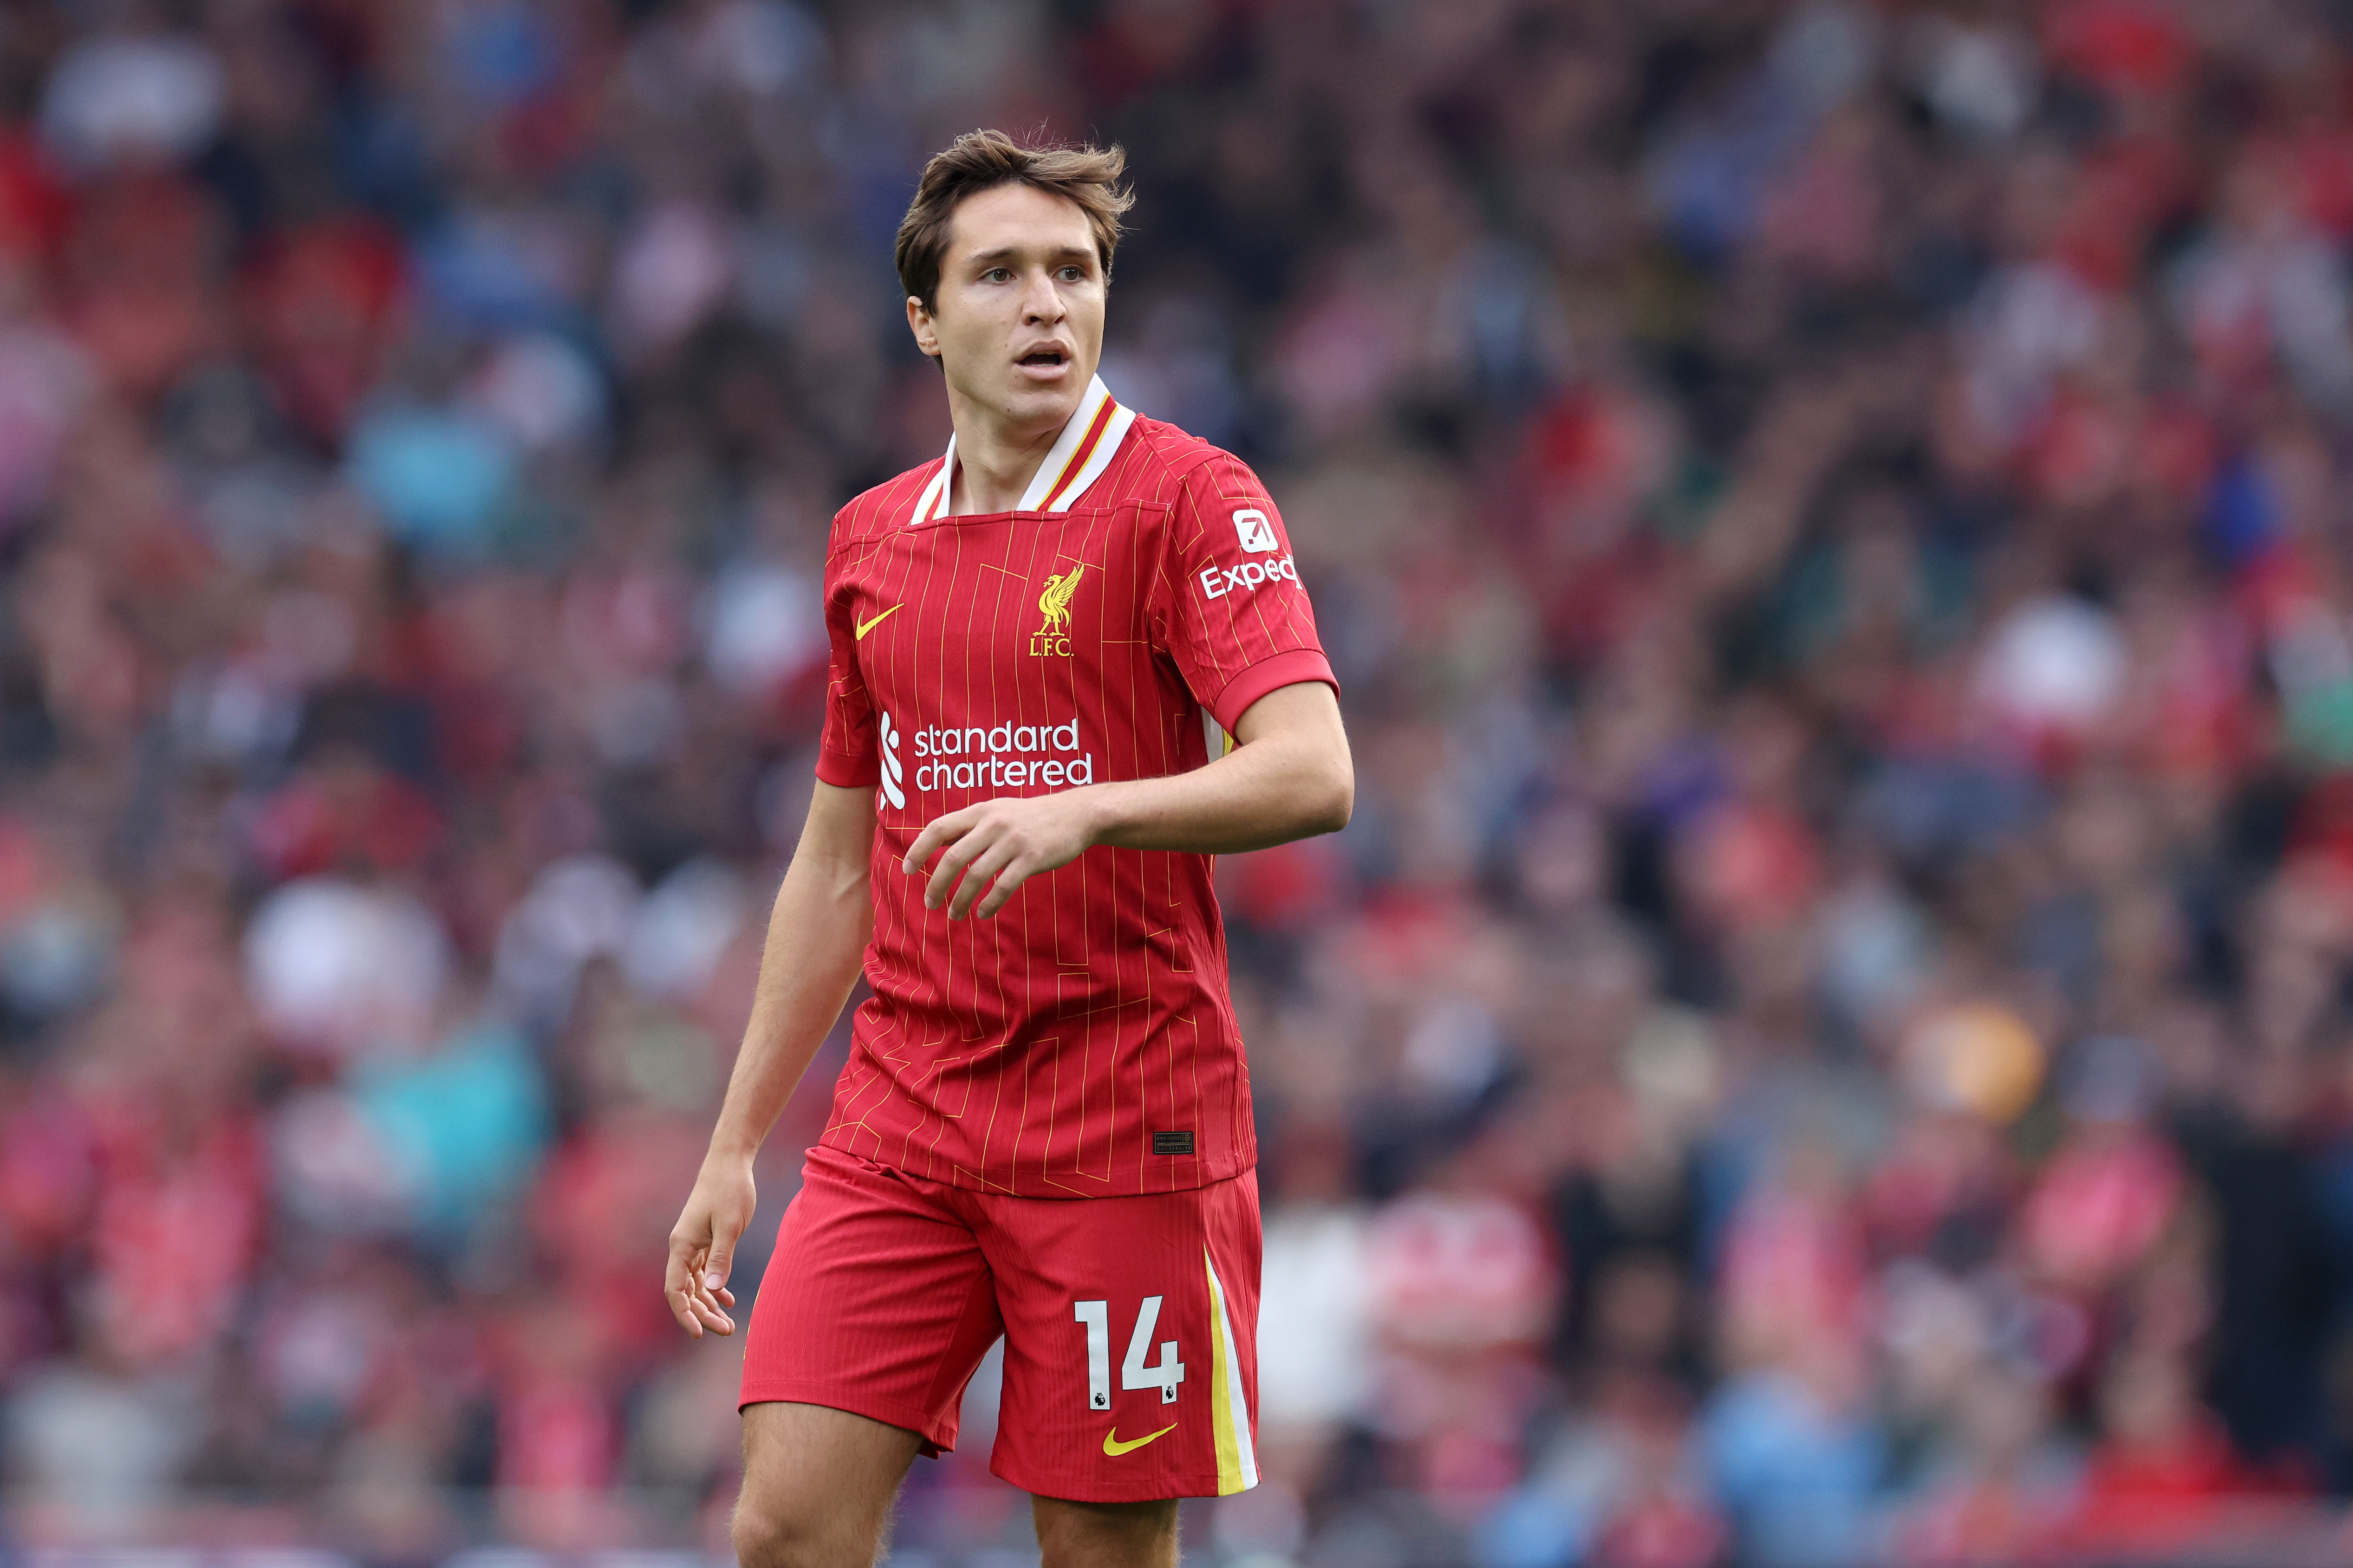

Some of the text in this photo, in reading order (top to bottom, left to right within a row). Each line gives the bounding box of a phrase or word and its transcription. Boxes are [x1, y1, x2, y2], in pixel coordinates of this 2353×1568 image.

[1200, 554, 1303, 599] Exped
[1029, 638, 1075, 657] L.F.C.
[915, 718, 1078, 757] standard
[916, 752, 1092, 791] chartered
[1074, 1295, 1185, 1410] 14
